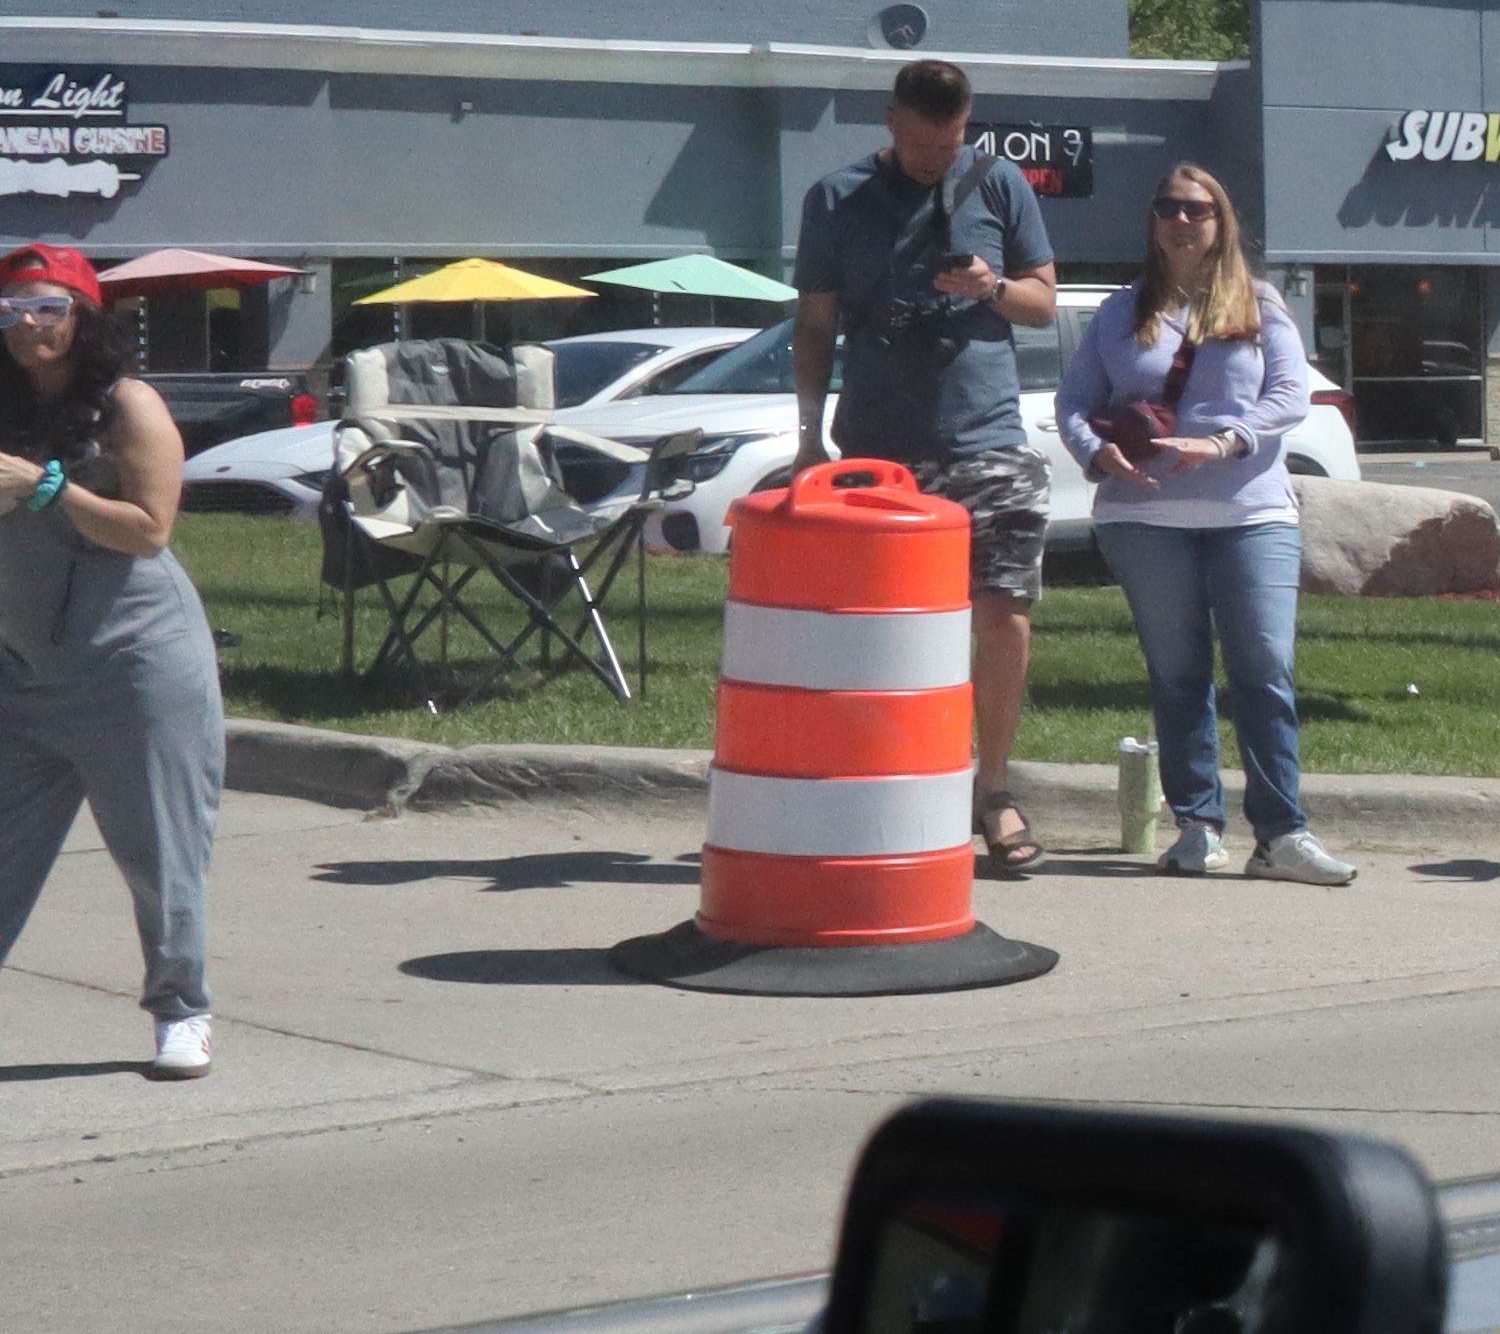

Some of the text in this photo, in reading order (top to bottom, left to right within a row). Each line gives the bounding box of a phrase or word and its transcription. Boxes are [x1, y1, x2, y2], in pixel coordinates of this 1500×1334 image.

[31, 73, 125, 119] Light
[74, 127, 166, 154] CUISINE
[974, 132, 1050, 161] ALON
